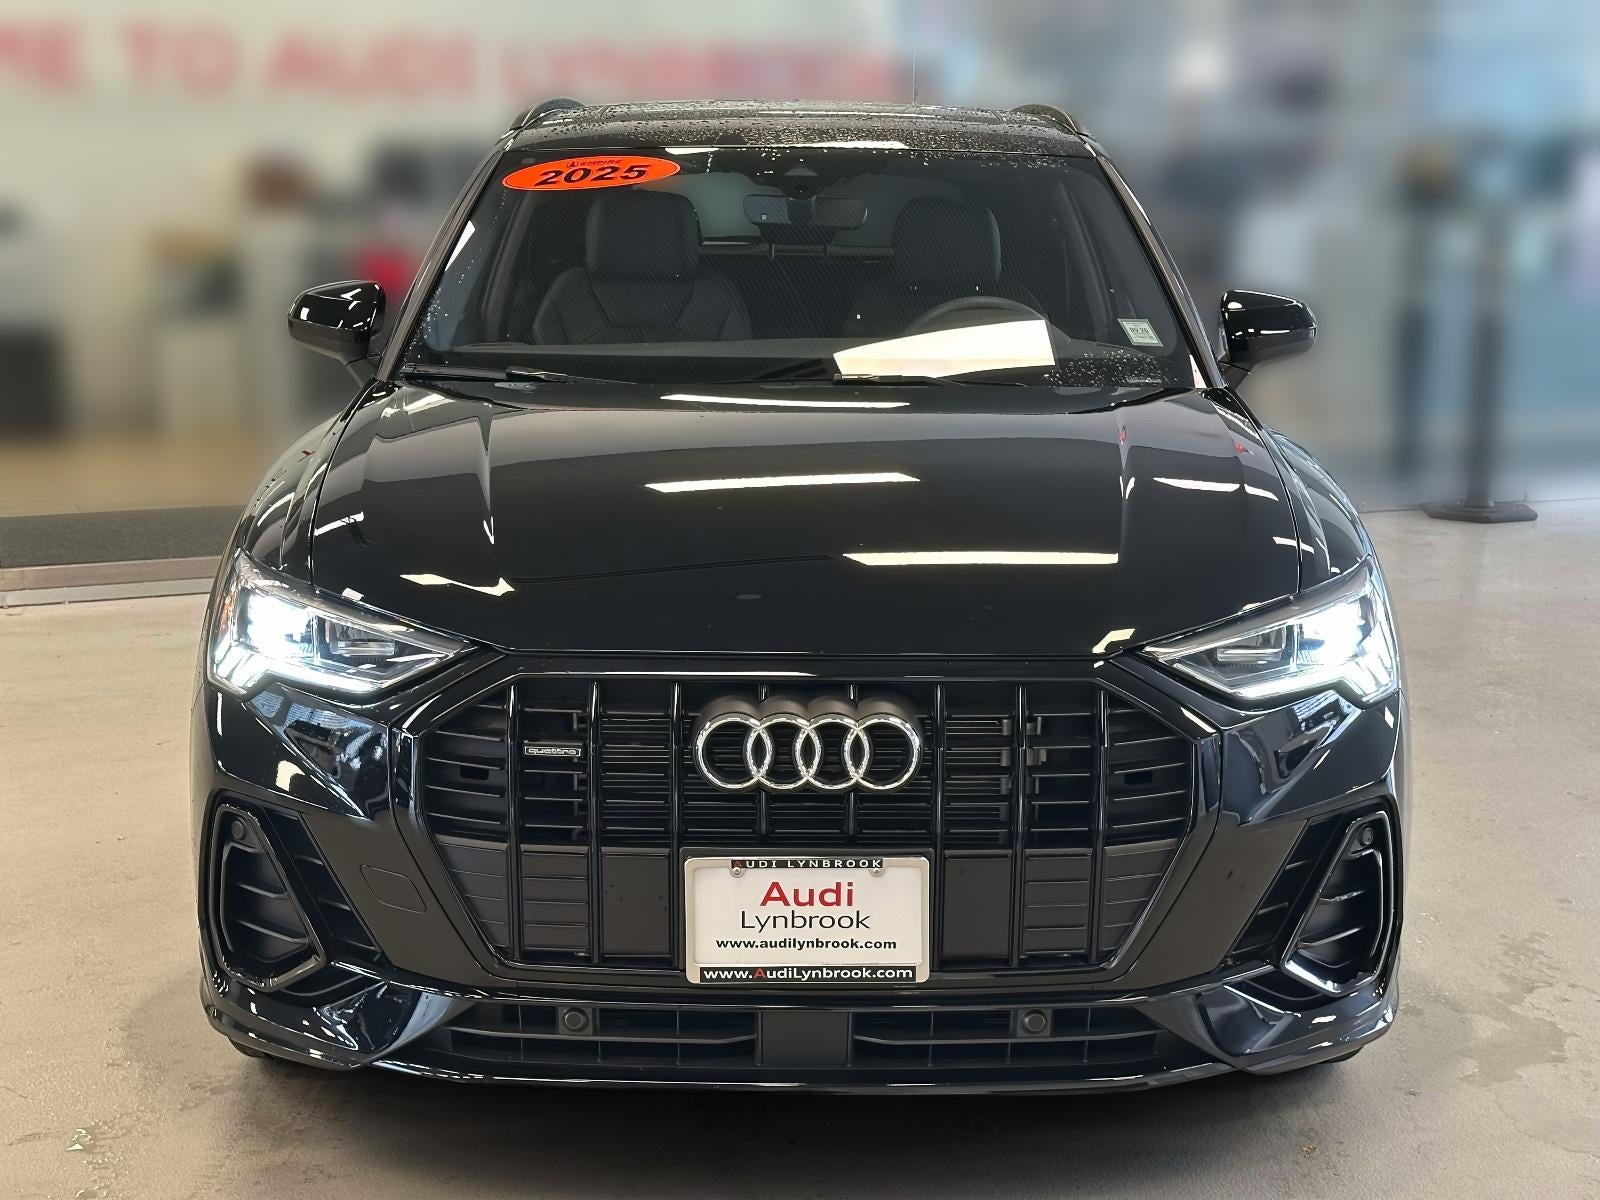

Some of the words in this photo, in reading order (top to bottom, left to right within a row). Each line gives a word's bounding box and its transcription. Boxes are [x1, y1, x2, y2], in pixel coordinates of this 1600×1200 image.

[534, 164, 650, 187] 2025
[734, 859, 777, 868] AUDI
[787, 859, 883, 868] LYNBROOK
[760, 881, 853, 907] Audi
[741, 910, 870, 933] Lynbrook
[715, 938, 897, 951] www.audilynbrook.com
[703, 967, 913, 982] www.AudiLynbrook.com
